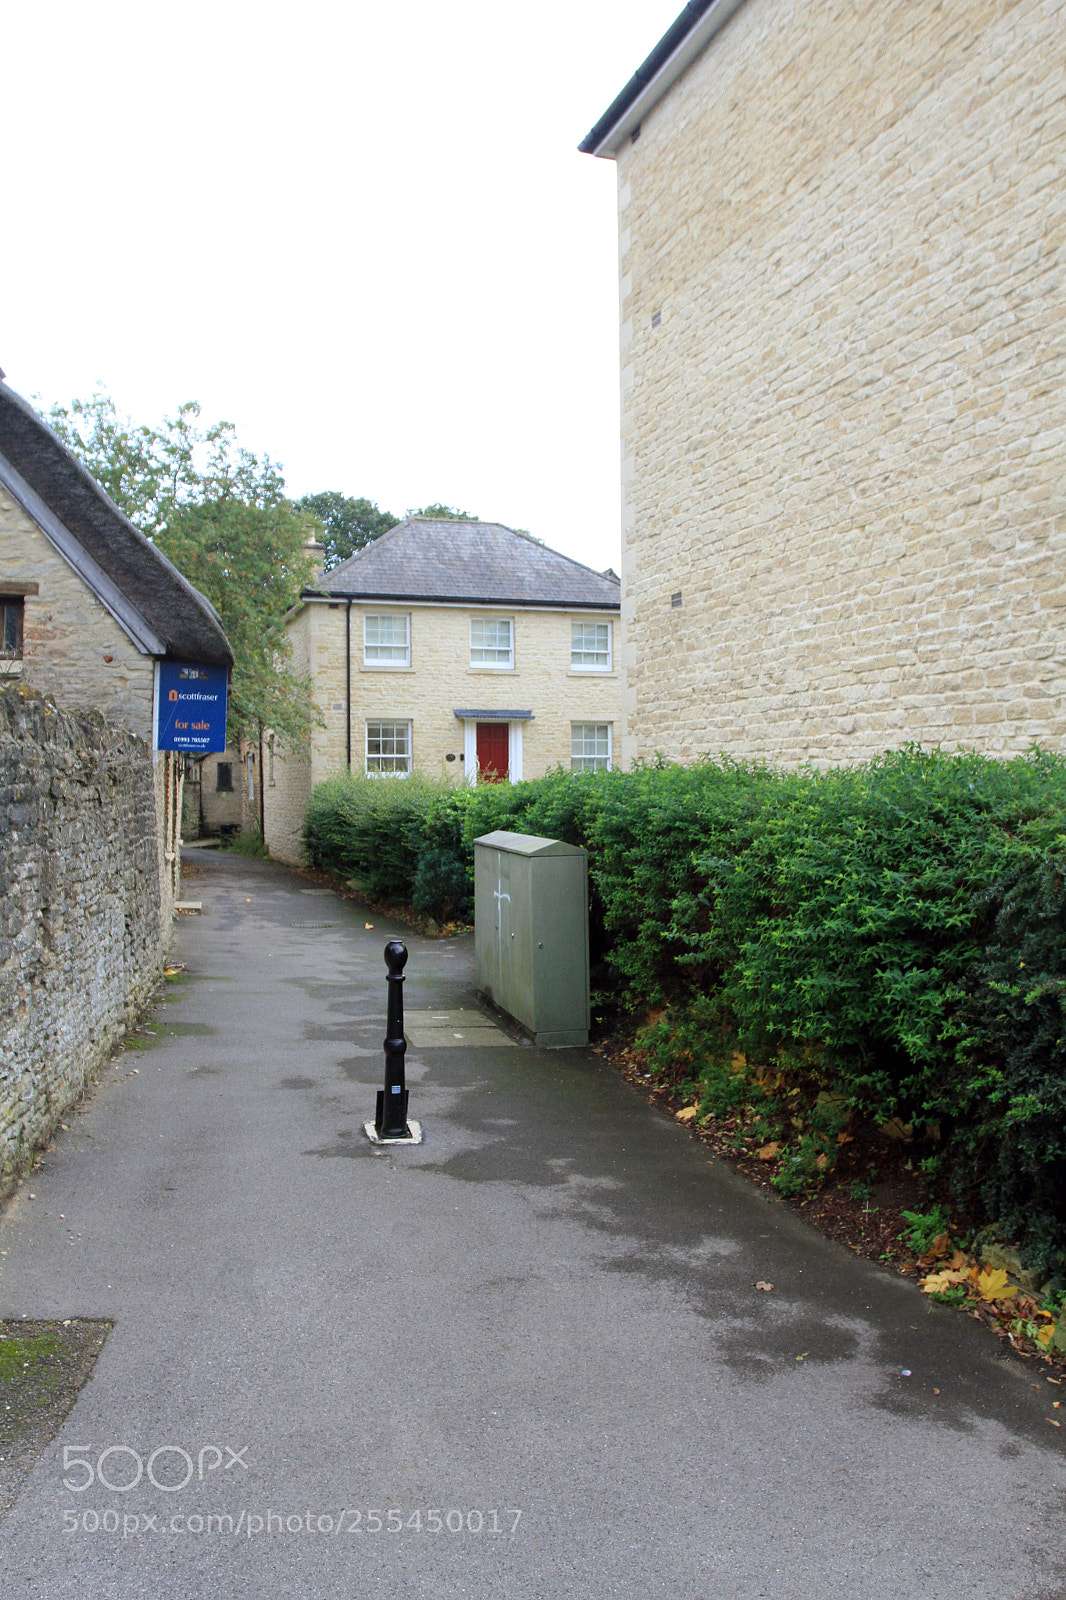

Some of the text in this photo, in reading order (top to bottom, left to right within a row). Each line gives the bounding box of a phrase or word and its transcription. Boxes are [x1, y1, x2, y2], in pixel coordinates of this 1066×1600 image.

[178, 692, 218, 701] scottfraser
[174, 719, 210, 730] for sale
